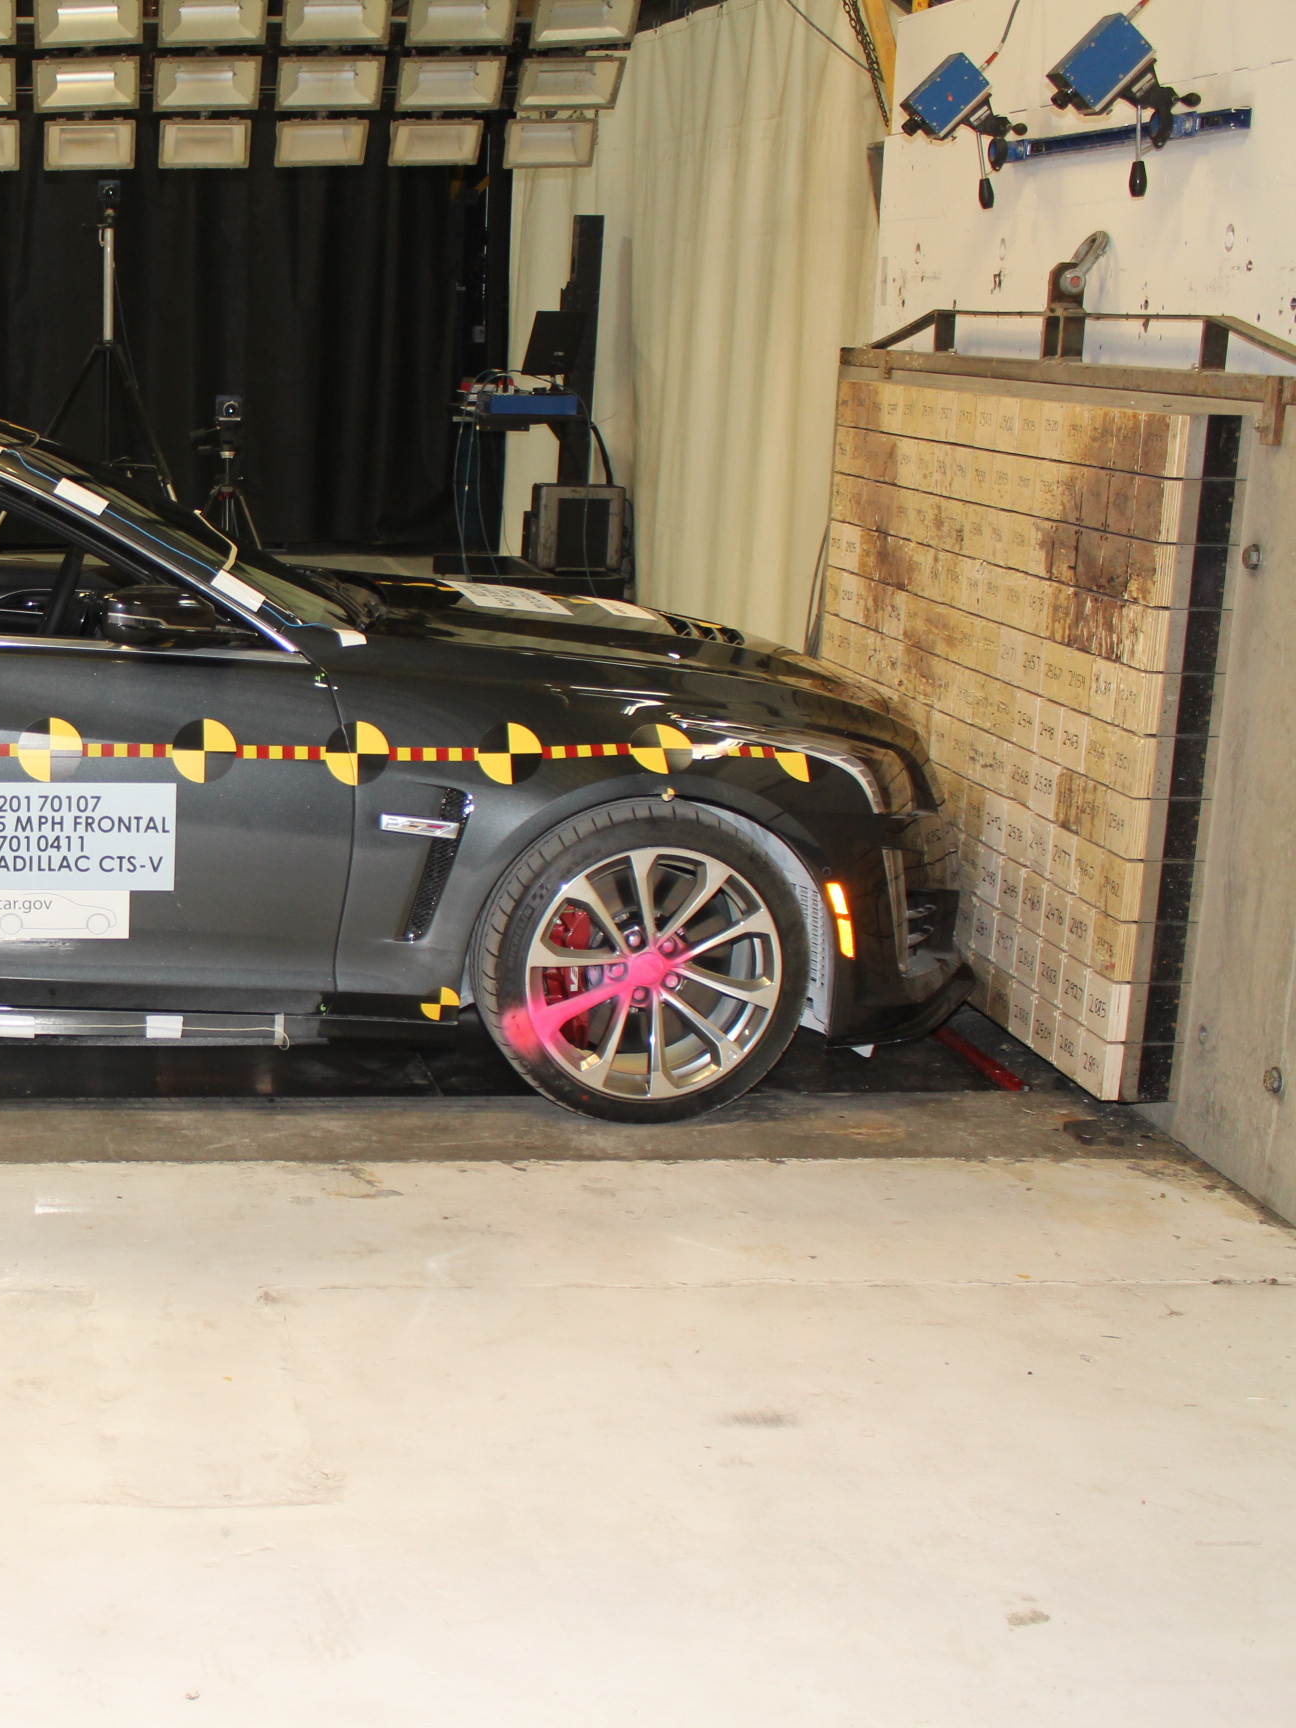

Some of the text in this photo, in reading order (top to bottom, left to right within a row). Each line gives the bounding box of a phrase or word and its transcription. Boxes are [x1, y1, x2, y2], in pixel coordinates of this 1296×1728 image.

[1044, 662, 1063, 682] 2567
[1063, 730, 1079, 750] 2463
[1034, 773, 1053, 797] 2538
[14, 815, 65, 833] MPH
[73, 816, 170, 834] FRONTAL
[1008, 824, 1023, 842] 2576
[98, 856, 163, 873] CTS-V
[1053, 844, 1071, 869] 2477
[1045, 902, 1063, 926] 2476
[1070, 916, 1087, 941] 2459
[1064, 978, 1083, 1003] 2927
